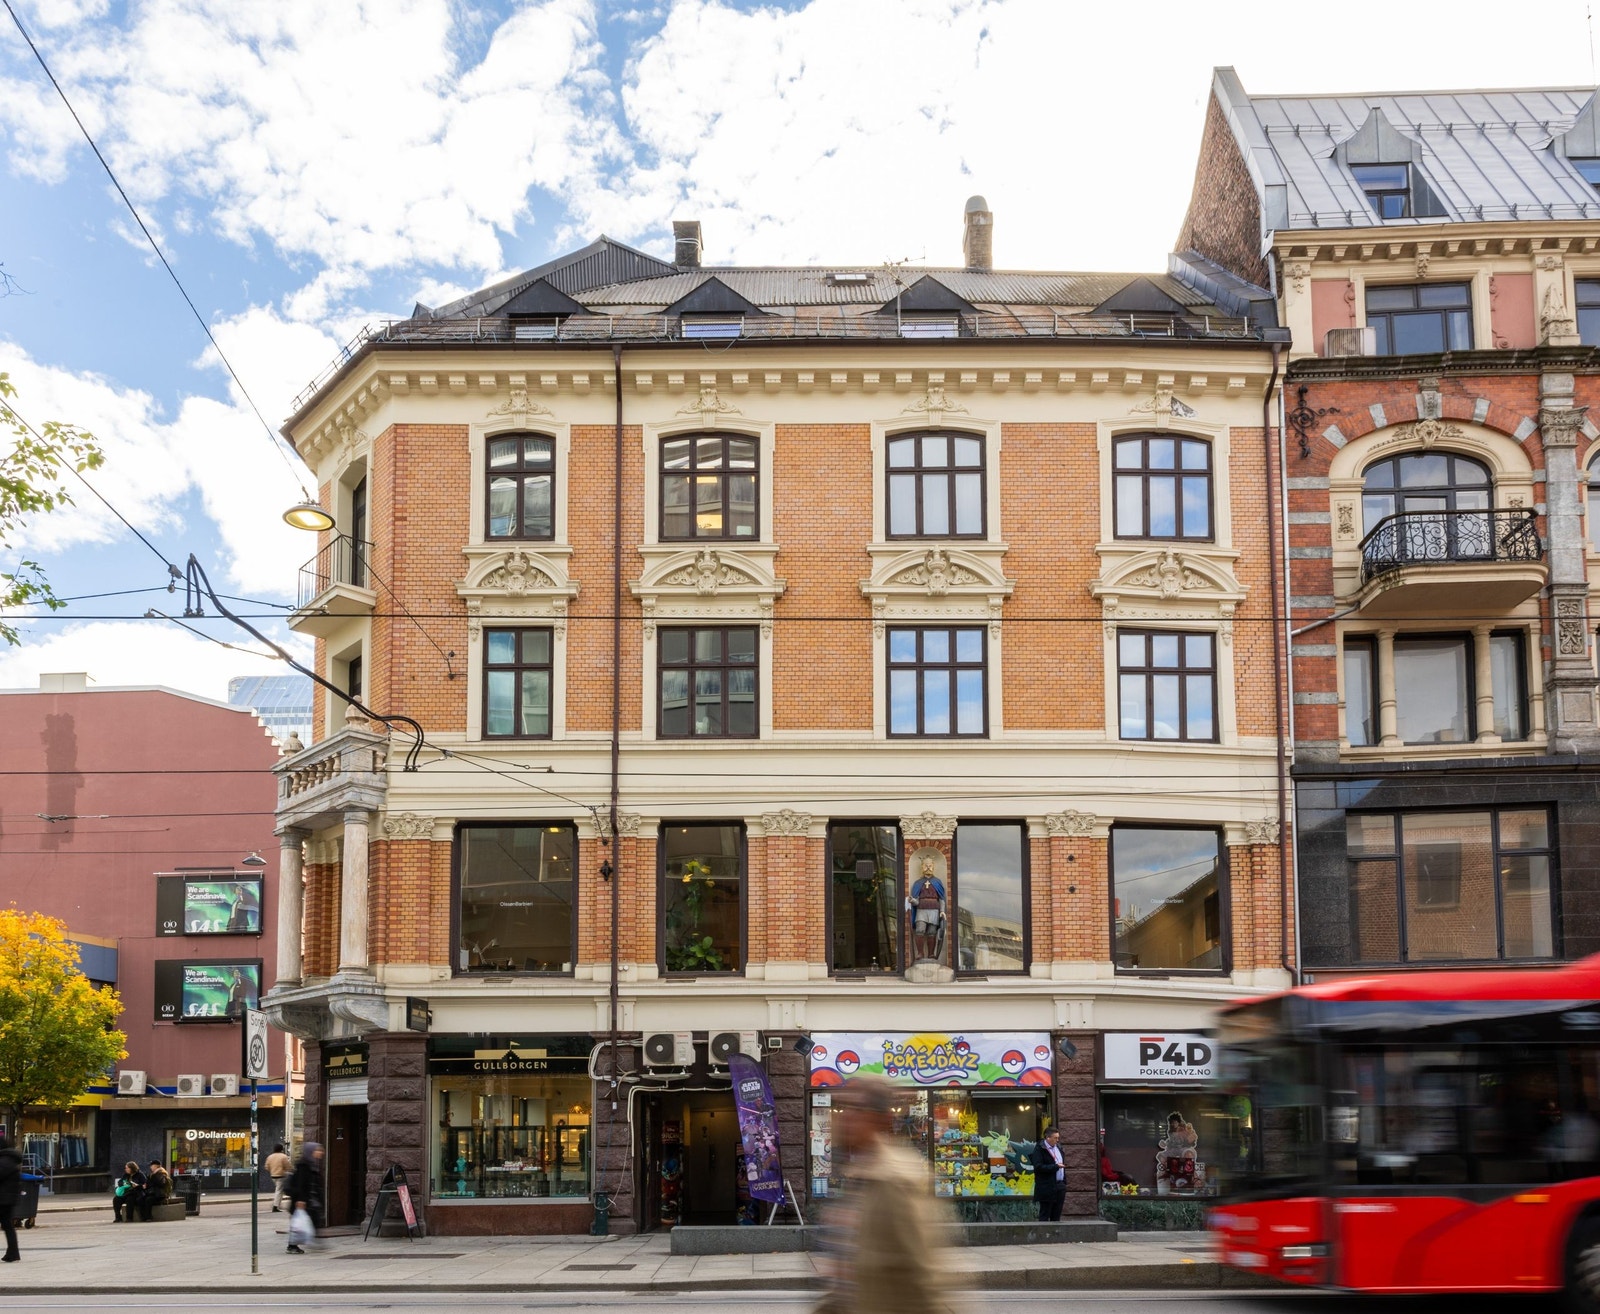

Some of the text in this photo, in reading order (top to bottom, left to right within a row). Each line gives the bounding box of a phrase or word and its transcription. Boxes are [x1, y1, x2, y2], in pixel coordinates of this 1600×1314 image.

[186, 919, 223, 933] SAS
[184, 1002, 221, 1017] SAS
[252, 1042, 263, 1064] 30
[1139, 1042, 1212, 1067] P4D
[329, 1066, 363, 1077] GULLBORGEN
[473, 1061, 548, 1070] GULLBORGEN
[1139, 1068, 1211, 1076] POKE4DAYZ.NO
[198, 1130, 246, 1139] Dollarstore
